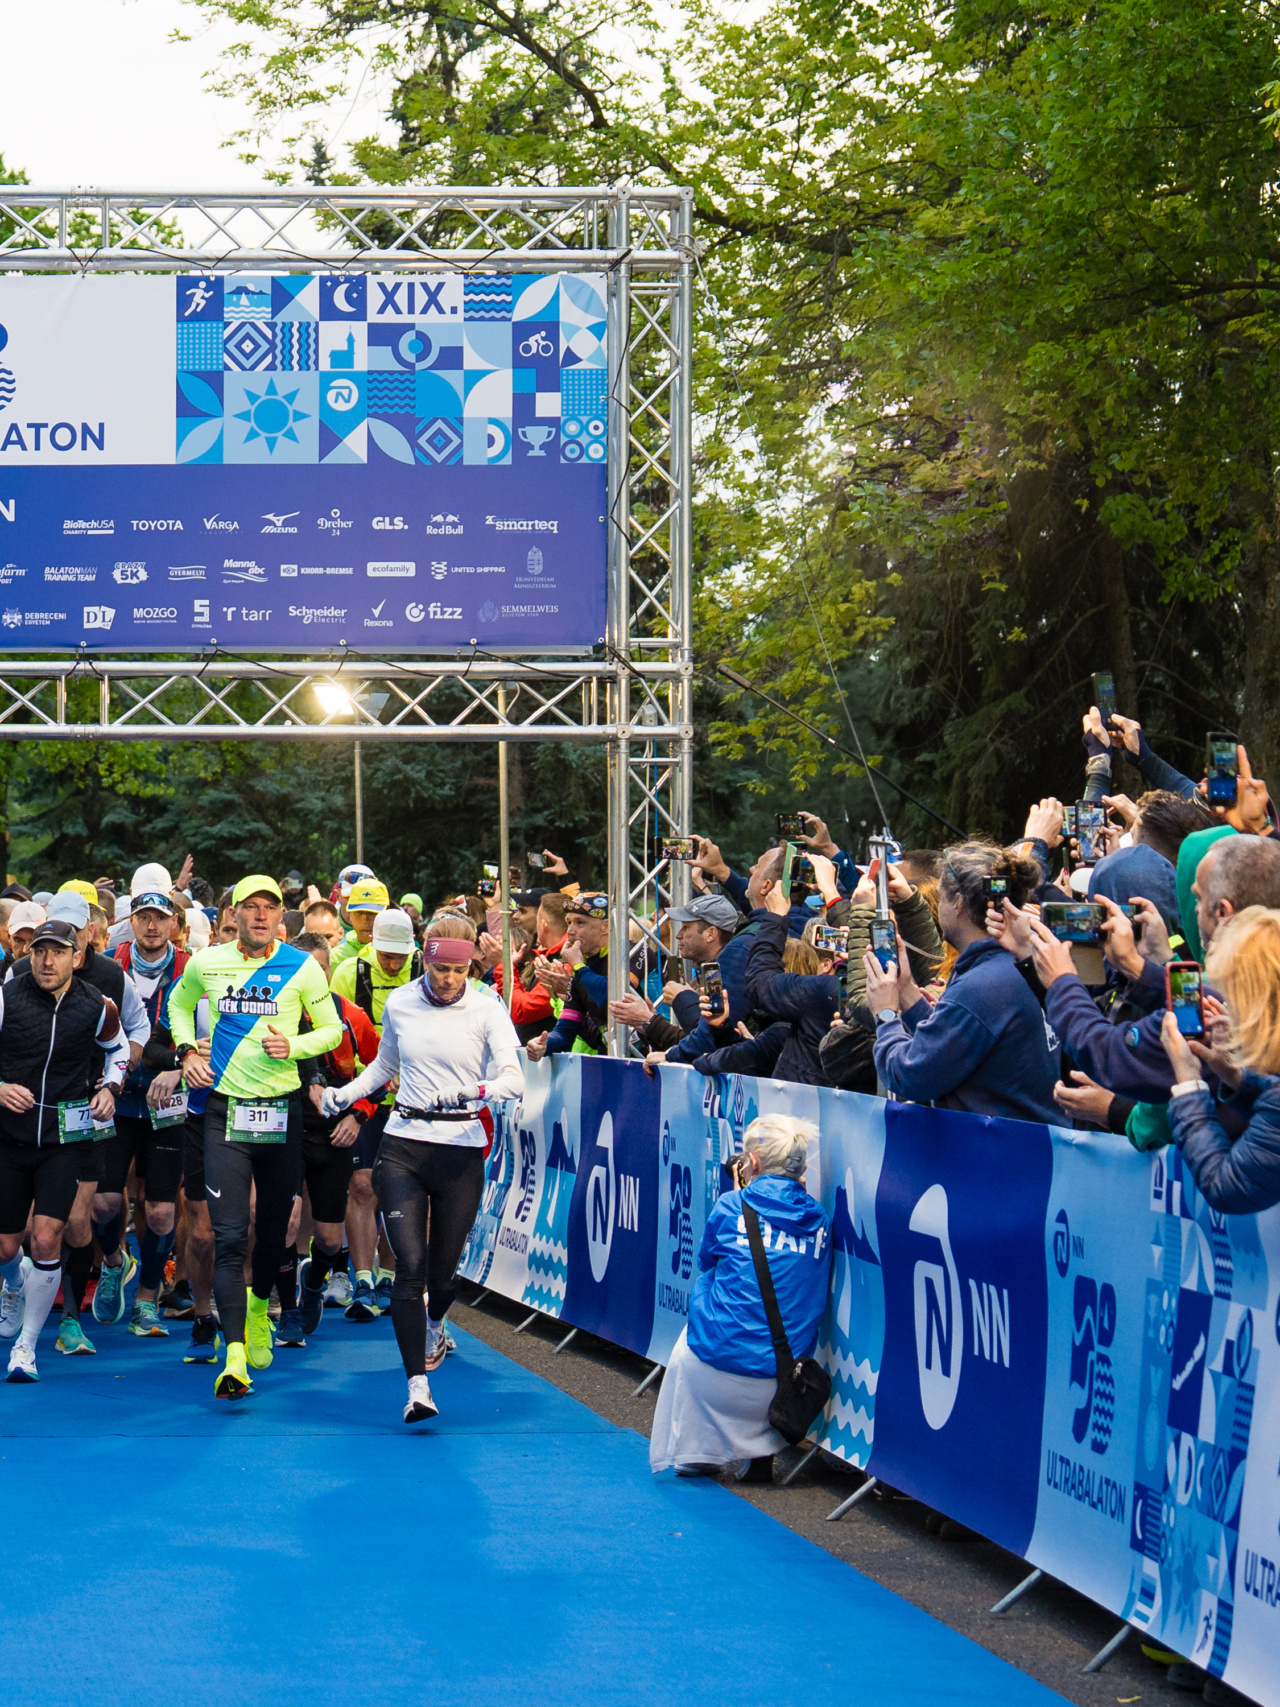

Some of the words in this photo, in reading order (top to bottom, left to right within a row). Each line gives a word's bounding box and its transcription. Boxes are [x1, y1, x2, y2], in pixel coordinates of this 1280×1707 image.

[376, 281, 459, 316] XIX.
[63, 519, 115, 529] BioTechUSA
[131, 520, 184, 531] TOYOTA
[203, 515, 240, 532] VARGA
[317, 517, 354, 530] Dreher
[371, 516, 409, 530] GLS.
[495, 519, 559, 534] smarteq
[426, 525, 445, 535] Red
[446, 525, 464, 535] Bull
[114, 562, 146, 570] CRAZY
[223, 559, 256, 568] Manna
[372, 564, 411, 574] ecofamily
[44, 566, 98, 575] BALATONMAN
[120, 569, 141, 582] 5K
[169, 568, 205, 577] GYERMELYI
[248, 566, 266, 575] abc
[300, 567, 354, 575] KNORR-BREMSE
[44, 574, 76, 582] TRAINING
[76, 574, 97, 582] TEAM
[133, 607, 178, 619] MOZGO
[241, 606, 273, 621] tarr
[288, 605, 348, 617] Schneider
[428, 602, 463, 619] fizz
[501, 604, 559, 613] SEMMELWEIS
[24, 612, 67, 620] DEBRECENI
[313, 616, 347, 624] Electric
[363, 618, 394, 627] Rexona
[249, 1109, 268, 1122] 311
[618, 1173, 640, 1233] NN
[1072, 1234, 1085, 1259] NN
[658, 1281, 691, 1317] ULTRABALA
[968, 1278, 1011, 1369] NN
[1046, 1448, 1127, 1525] ULTRABALATON
